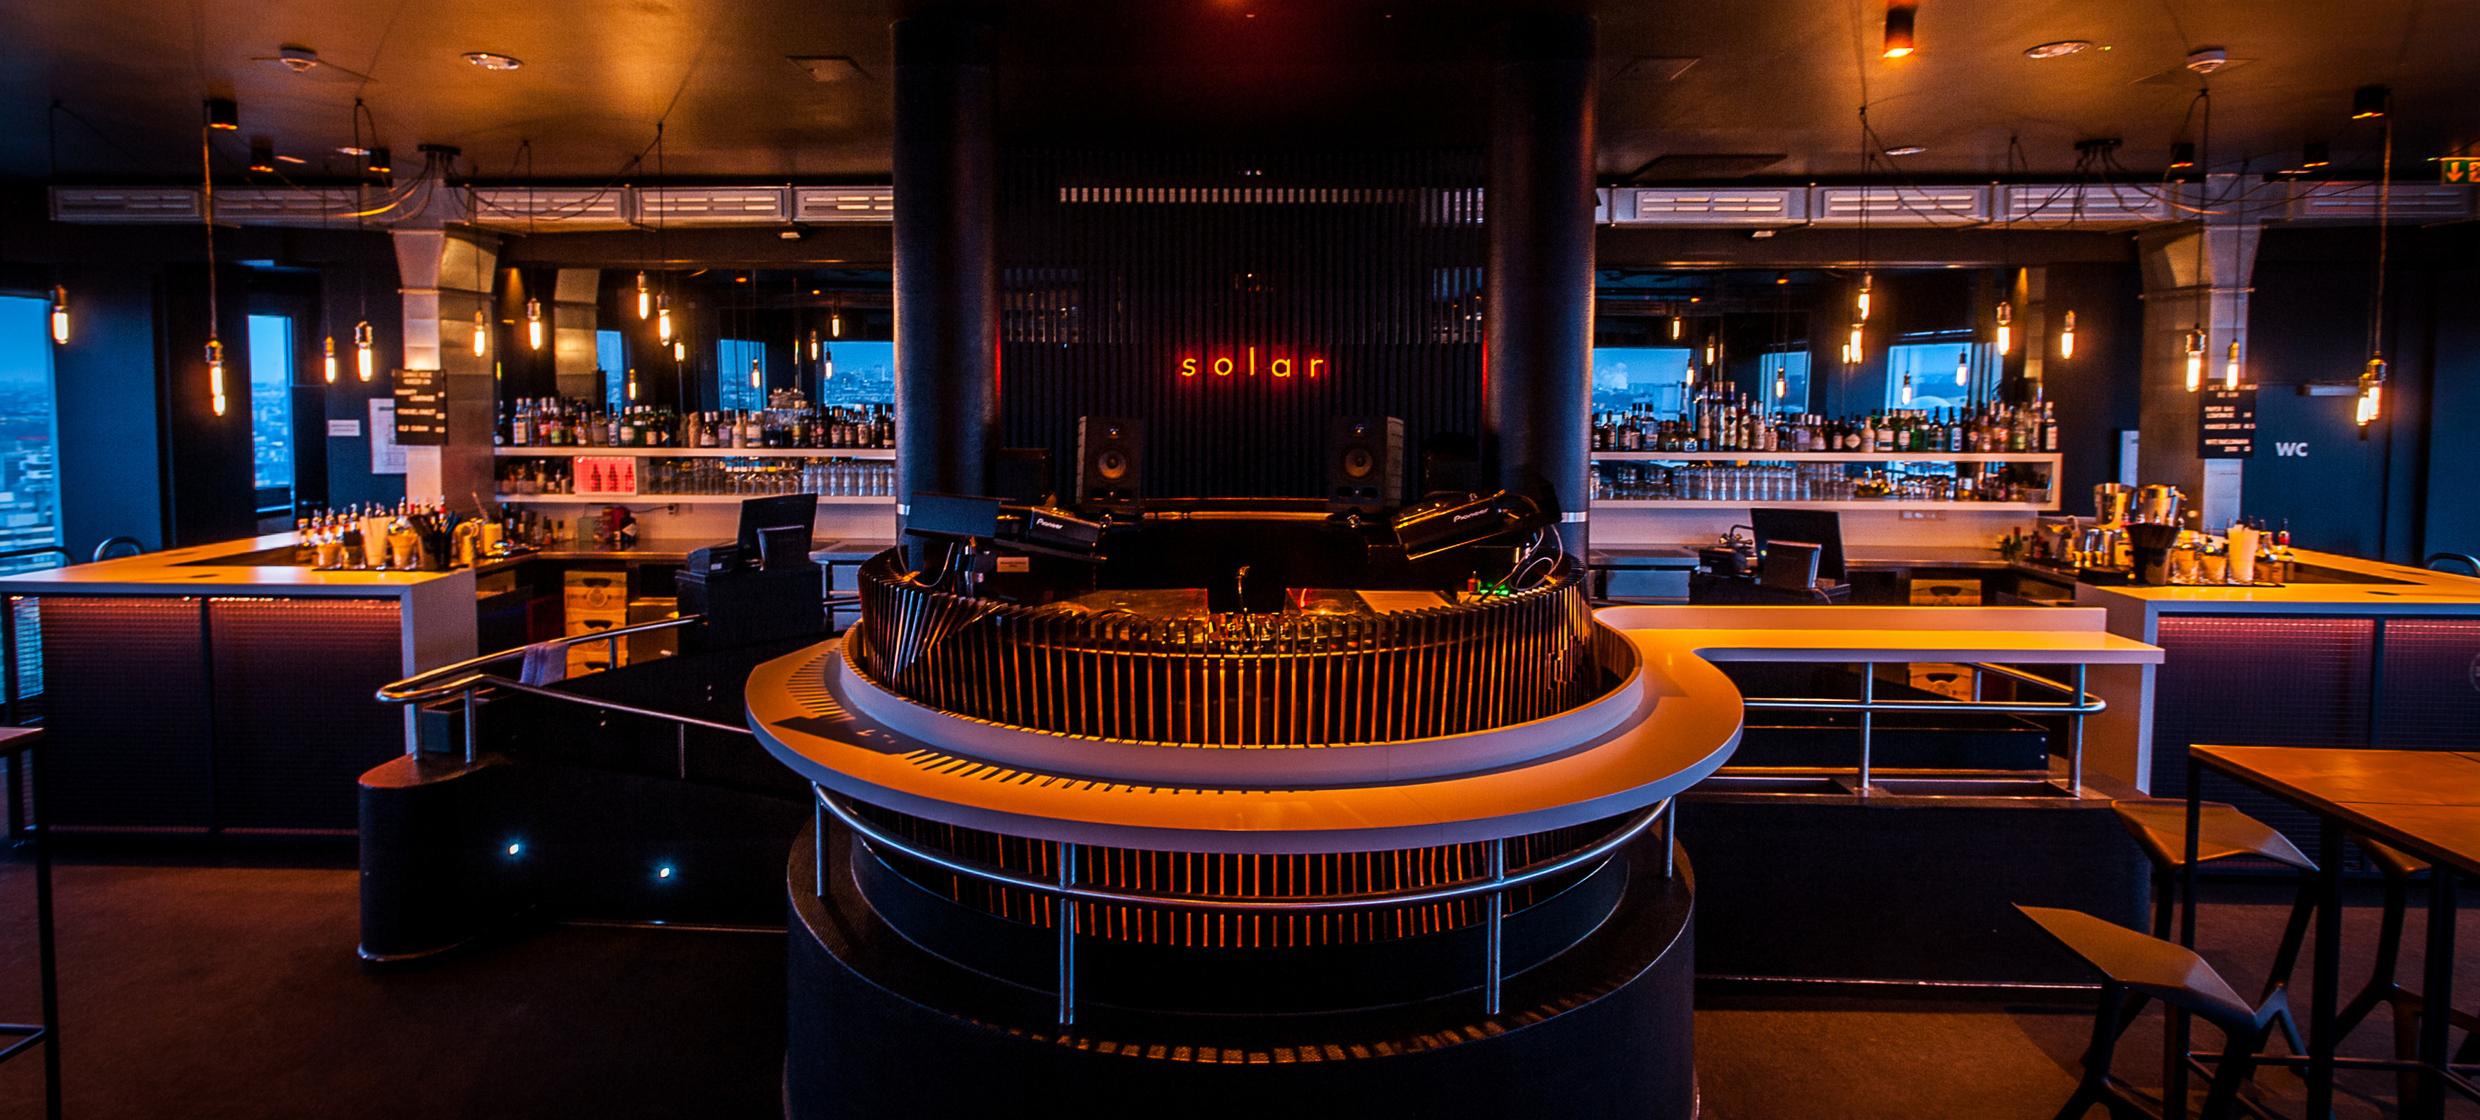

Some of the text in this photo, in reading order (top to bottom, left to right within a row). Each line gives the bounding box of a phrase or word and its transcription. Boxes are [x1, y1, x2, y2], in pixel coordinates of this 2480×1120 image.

[1181, 346, 1324, 378] solar
[2275, 441, 2309, 457] WC
[1453, 507, 1489, 523] Pioneer
[1036, 517, 1064, 530] Pioneer
